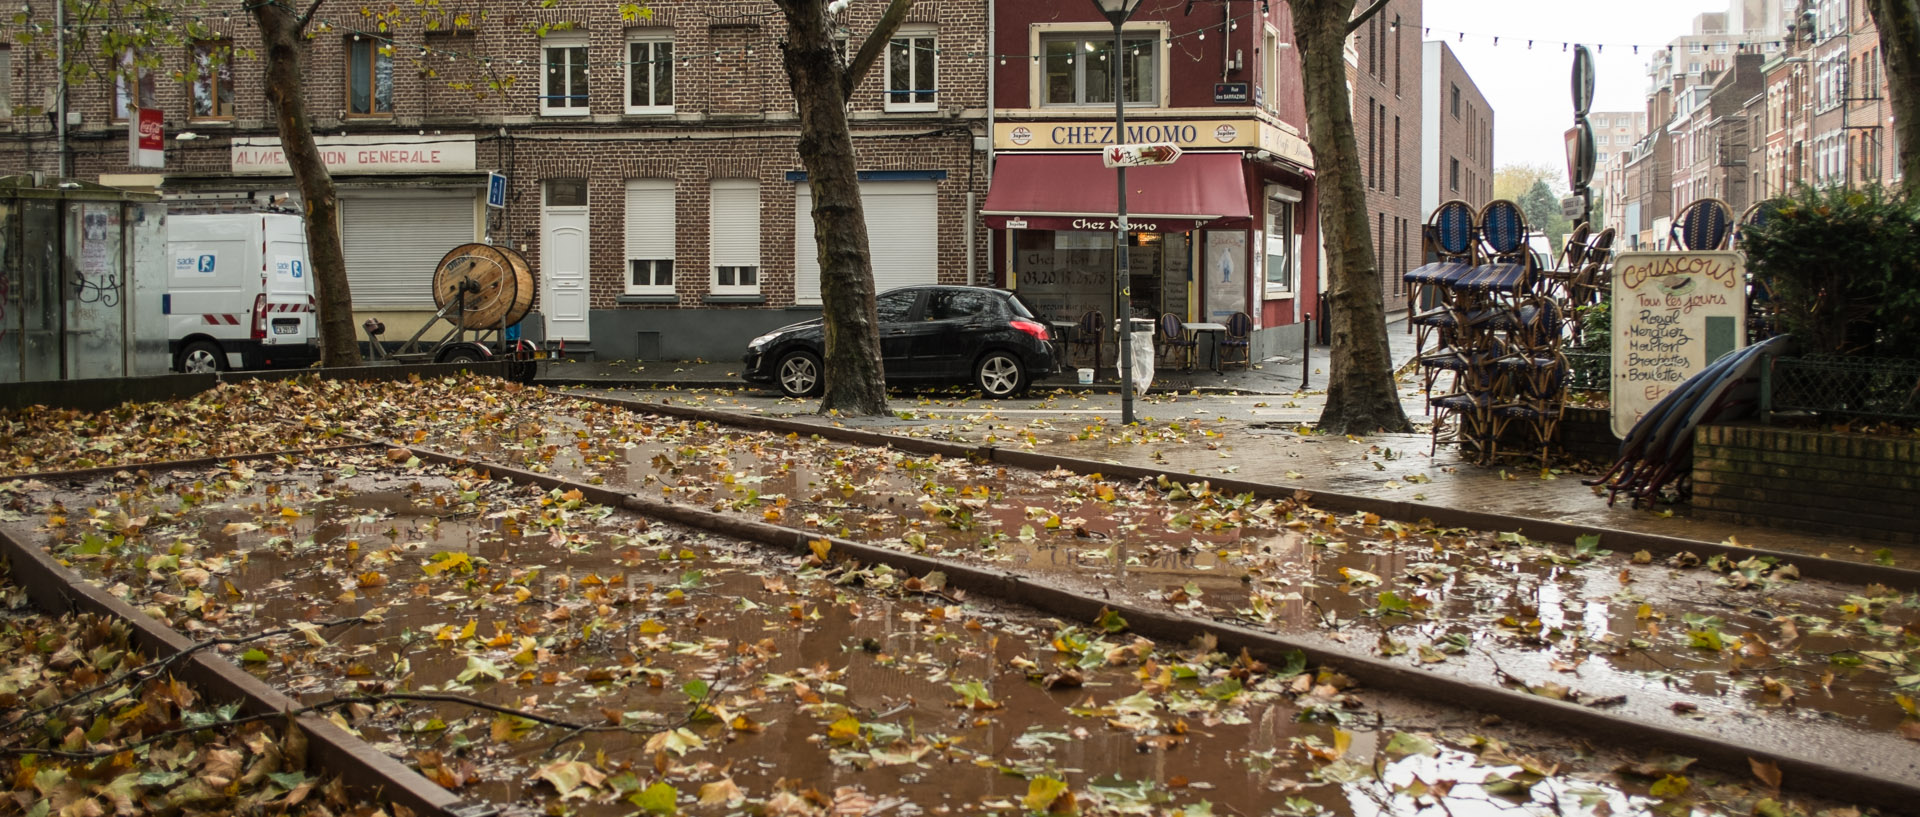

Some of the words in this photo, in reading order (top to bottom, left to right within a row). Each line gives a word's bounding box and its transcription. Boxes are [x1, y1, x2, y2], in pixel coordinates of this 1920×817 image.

[1051, 126, 1114, 145] CHEZ
[1127, 125, 1197, 144] MOMO
[235, 151, 346, 165] ALIMEION
[358, 150, 441, 163] GENERALE
[1072, 219, 1105, 230] Chez
[1623, 256, 1736, 289] Couscous
[1637, 293, 1661, 307] Tous
[1665, 293, 1682, 308] les
[1683, 293, 1727, 314] jours
[1639, 310, 1680, 329] Royal
[1630, 325, 1693, 345] Merguez
[1630, 340, 1681, 353] Mouton
